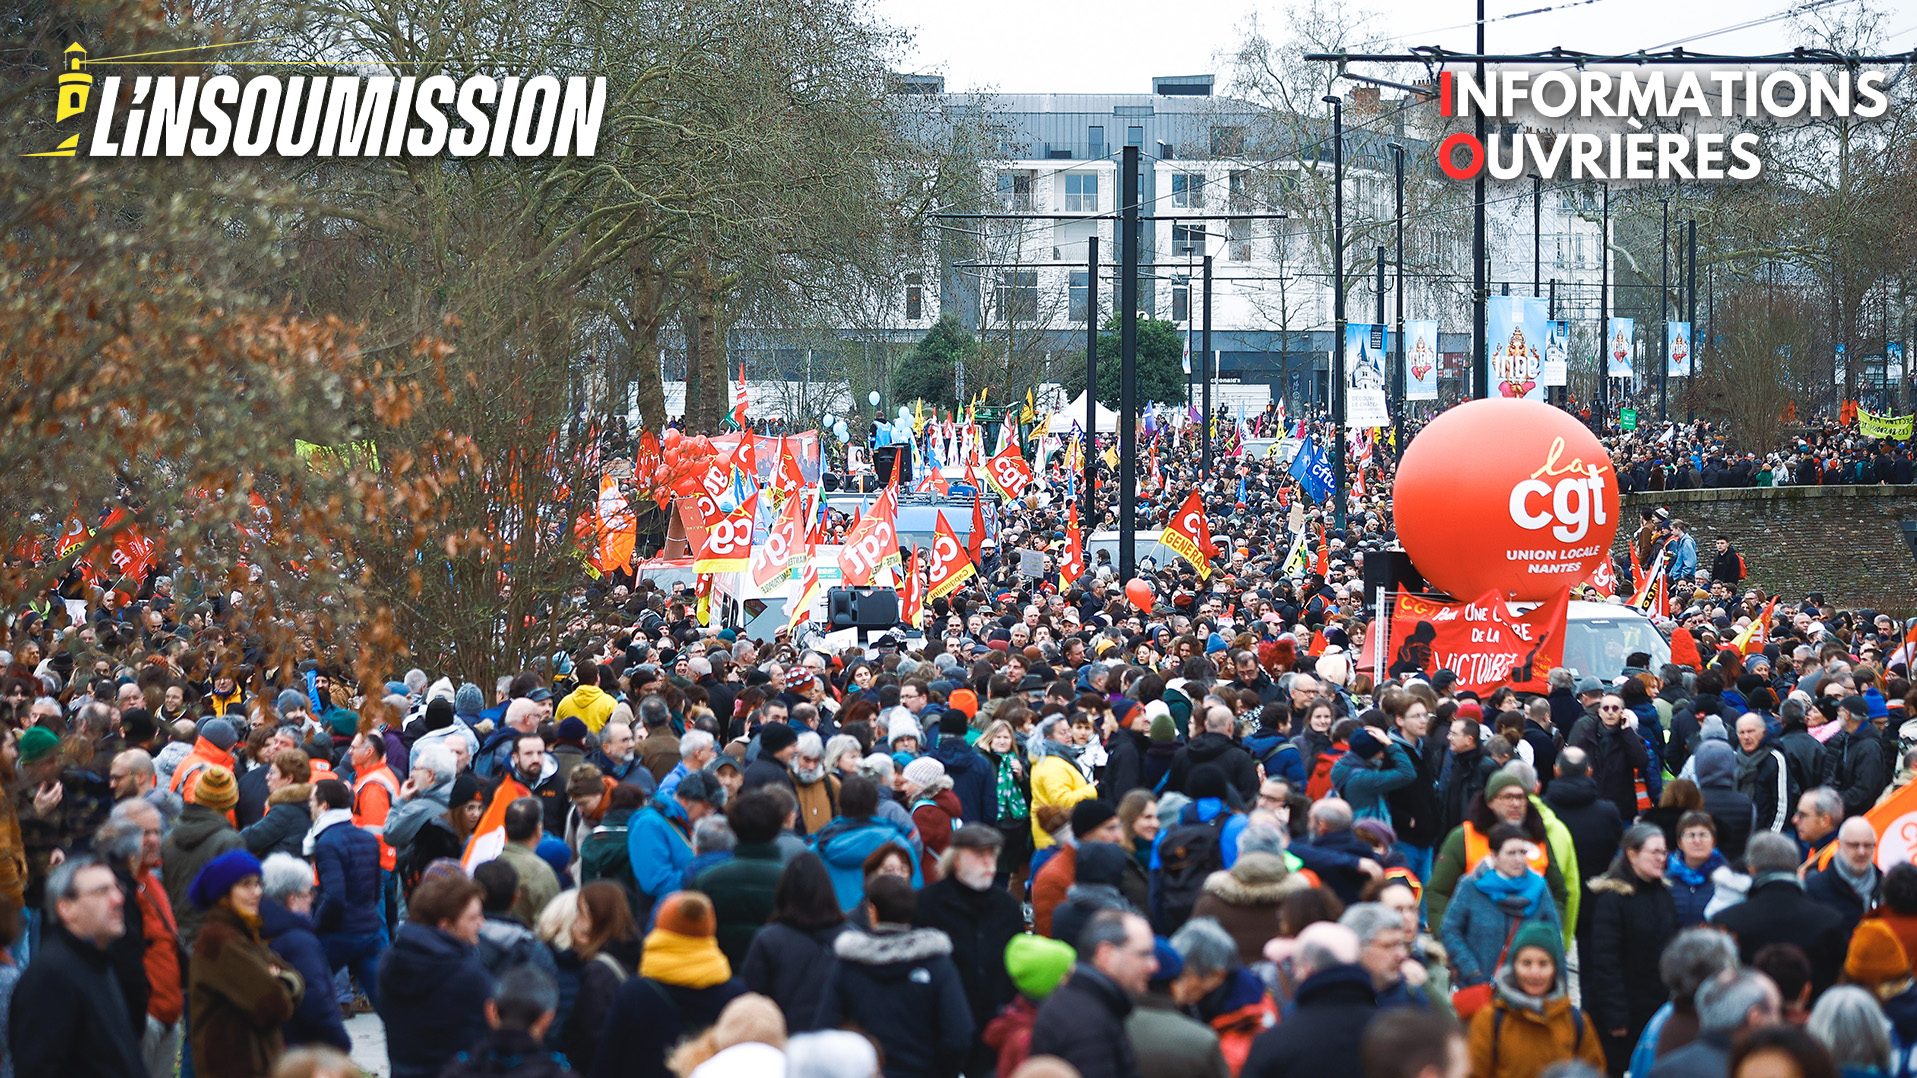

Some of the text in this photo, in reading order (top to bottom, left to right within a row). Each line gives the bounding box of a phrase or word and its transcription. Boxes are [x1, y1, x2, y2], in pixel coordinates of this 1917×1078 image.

[1530, 436, 1608, 480] la
[994, 456, 1029, 495] cgt
[1508, 464, 1607, 543] cgt
[1506, 545, 1601, 561] UNION LOCALE
[1527, 562, 1582, 574] NANTES
[1464, 602, 1489, 622] UNE
[1472, 627, 1500, 643] DE LA
